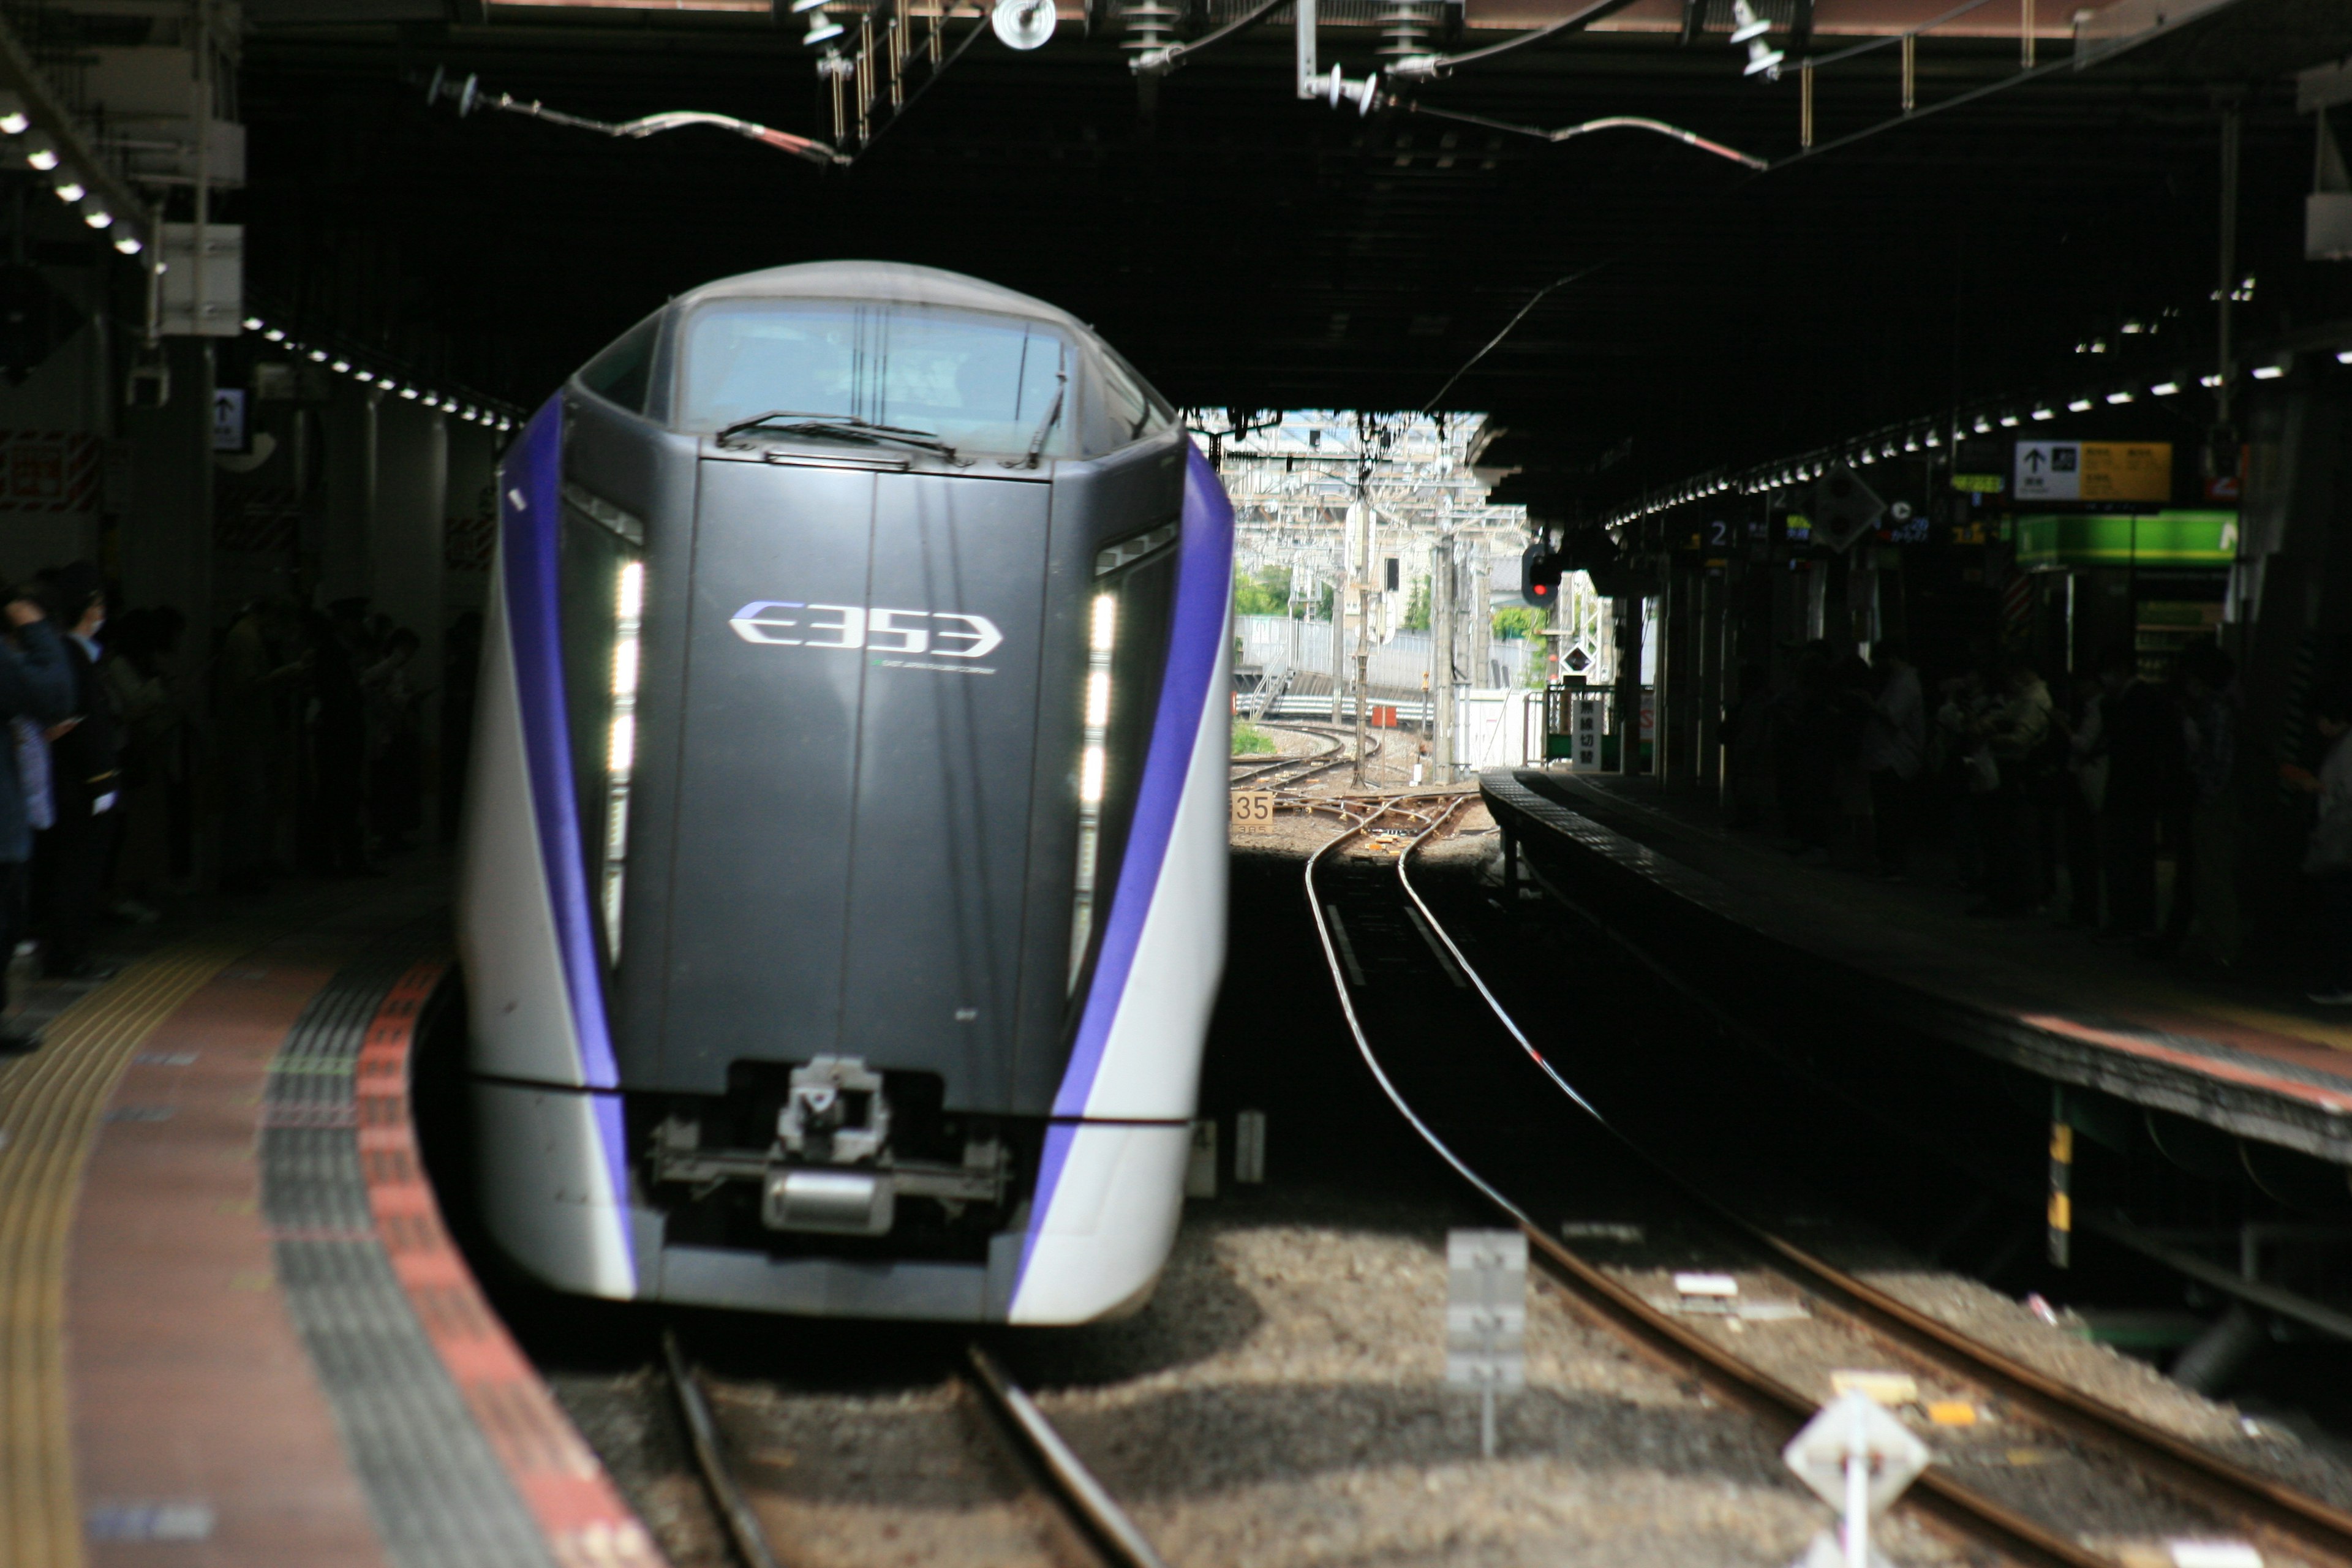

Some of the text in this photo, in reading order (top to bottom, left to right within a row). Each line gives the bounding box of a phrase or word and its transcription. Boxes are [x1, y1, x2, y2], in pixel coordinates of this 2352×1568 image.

[1711, 521, 1726, 546] 2
[729, 600, 1003, 657] E353
[1237, 796, 1268, 820] 35
